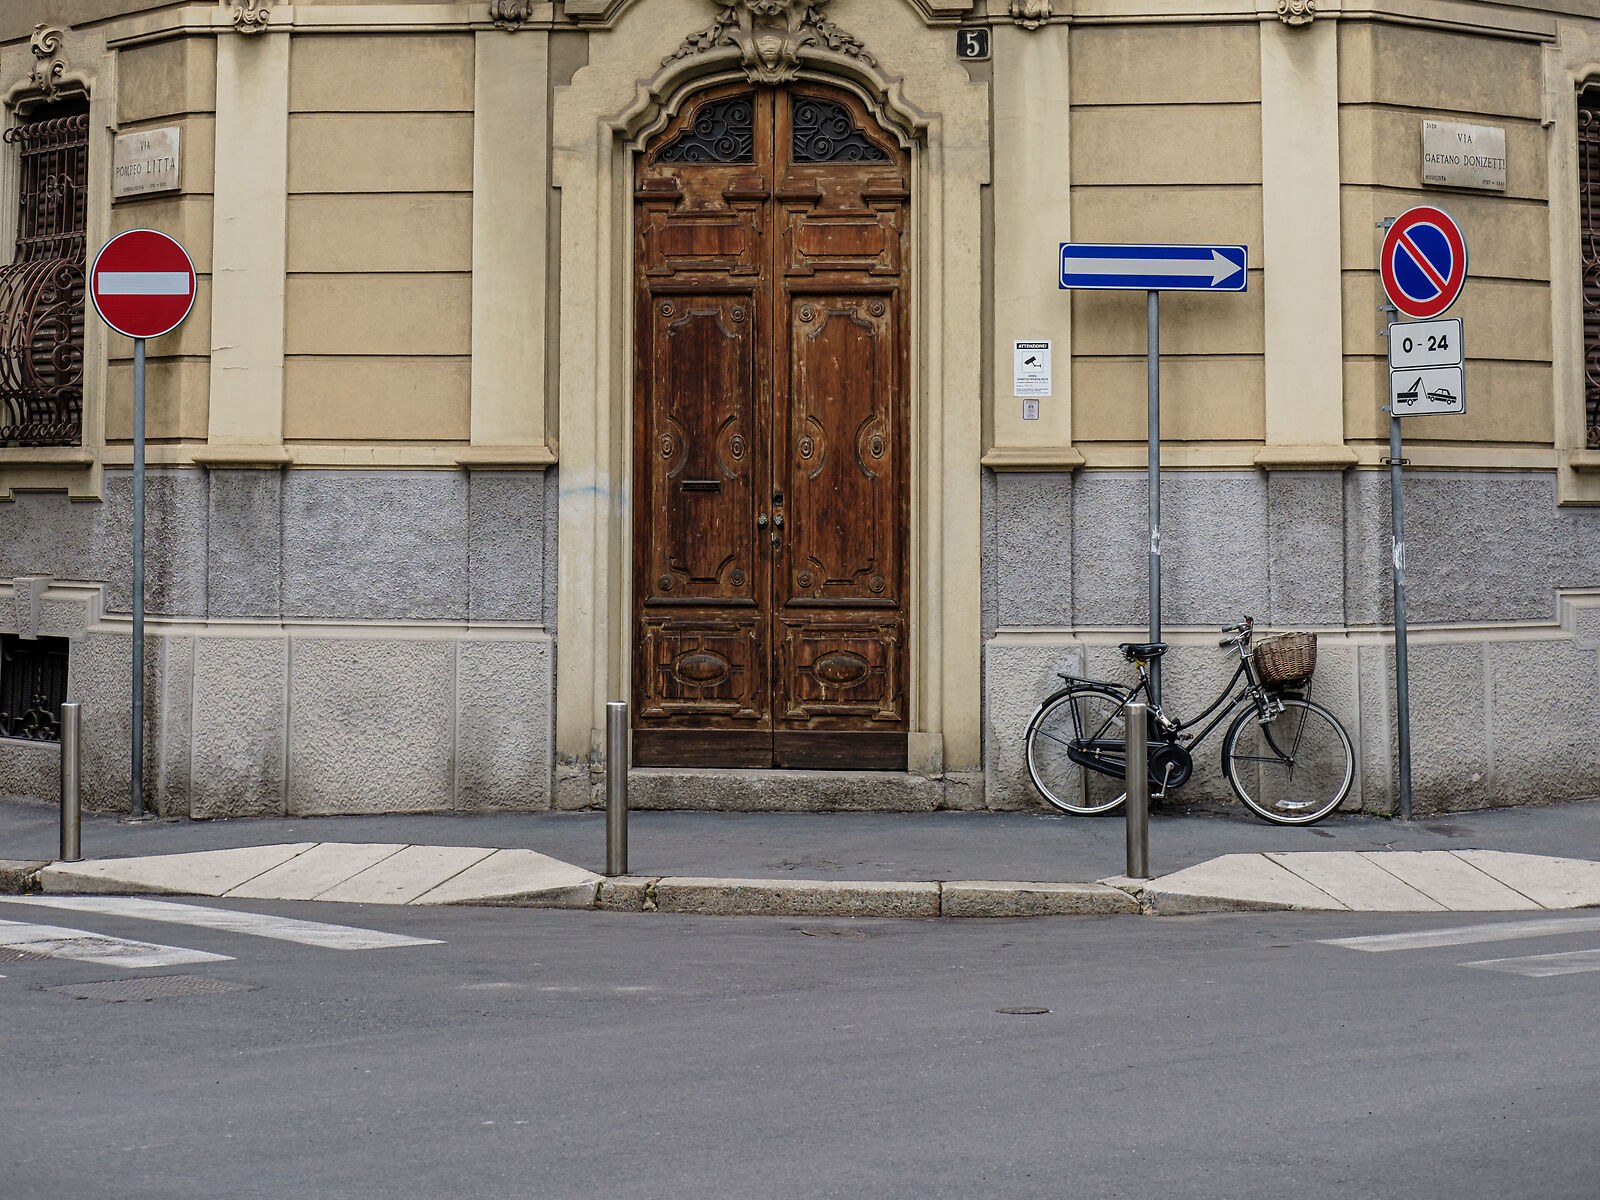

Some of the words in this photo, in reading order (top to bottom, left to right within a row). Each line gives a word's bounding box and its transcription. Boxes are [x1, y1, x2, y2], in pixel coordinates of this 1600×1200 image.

[966, 31, 980, 57] 5
[140, 141, 151, 151] VIA
[1457, 133, 1473, 144] VIA
[116, 163, 142, 178] POMPEO
[146, 157, 175, 174] LITTA
[1424, 153, 1460, 165] GAETANO
[1463, 155, 1505, 170] DONIZETTI
[1402, 337, 1413, 353] 0
[1427, 335, 1448, 351] 24
